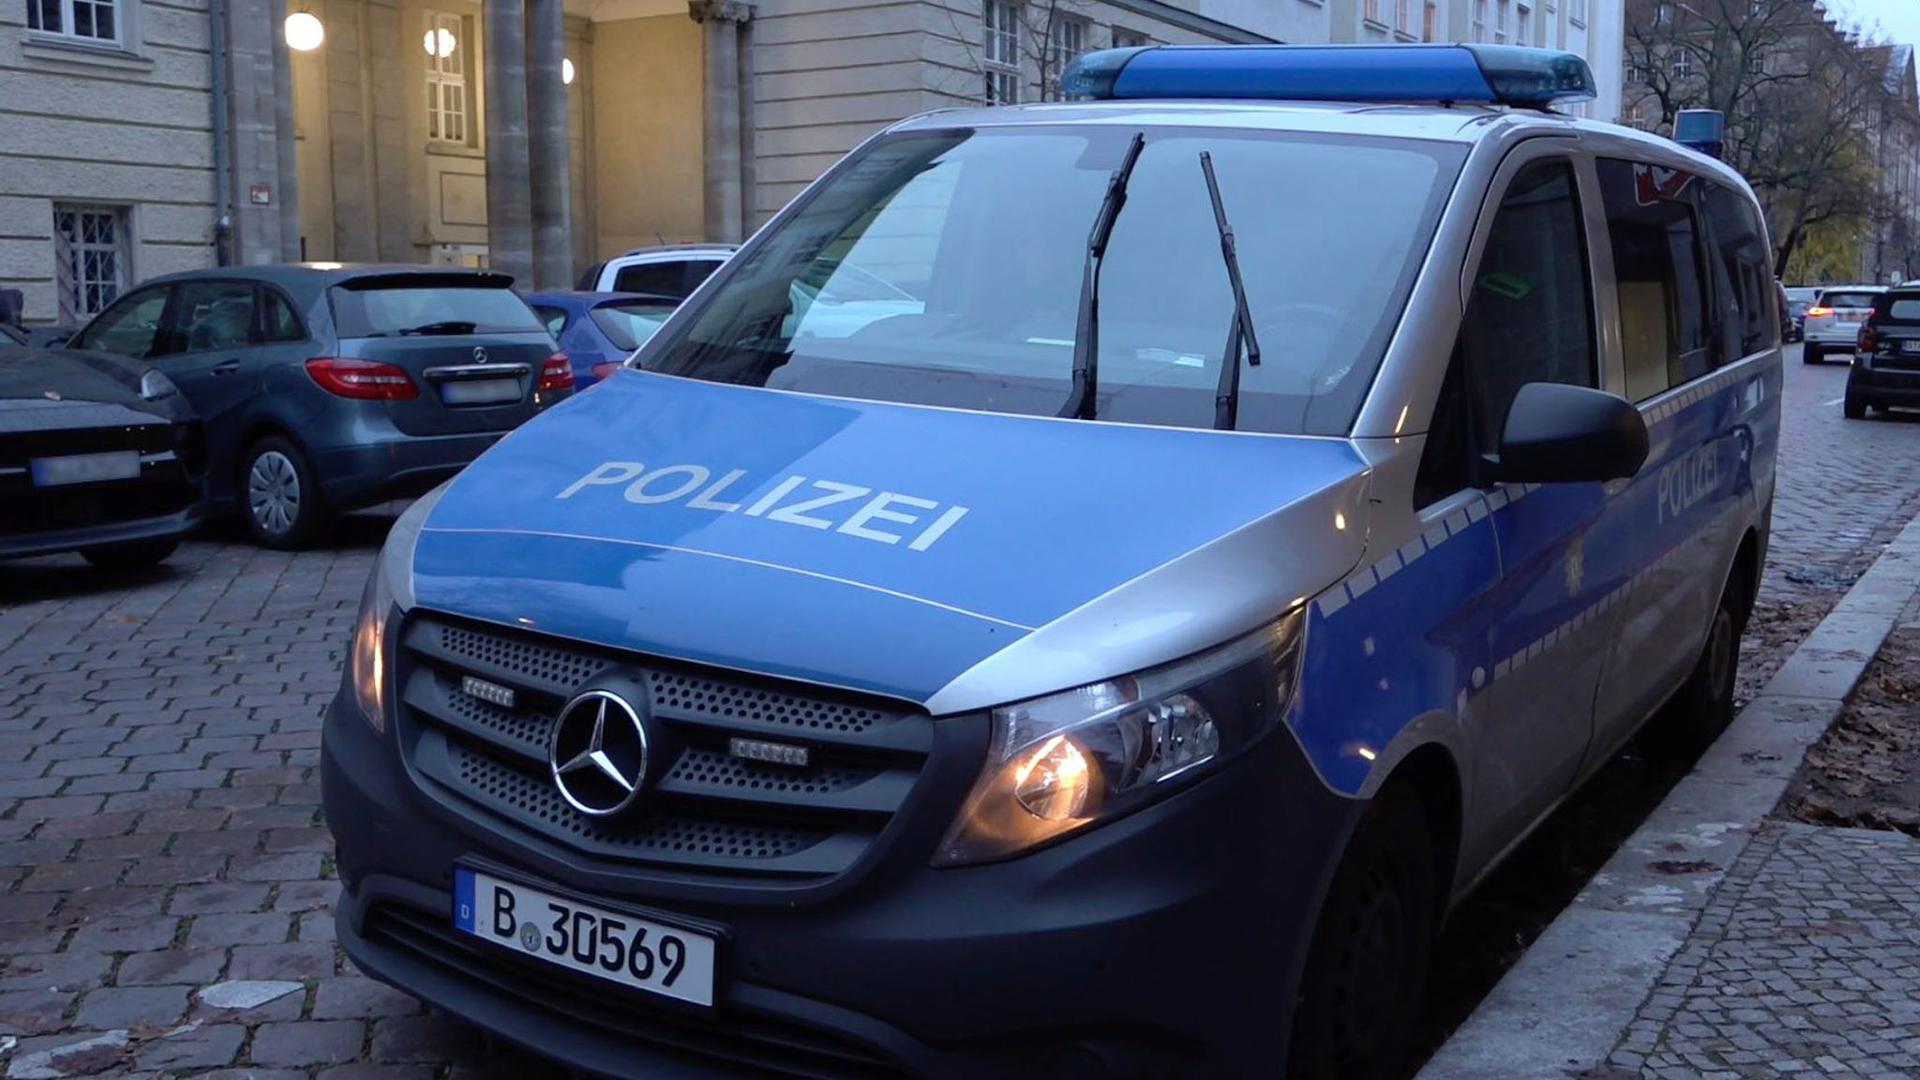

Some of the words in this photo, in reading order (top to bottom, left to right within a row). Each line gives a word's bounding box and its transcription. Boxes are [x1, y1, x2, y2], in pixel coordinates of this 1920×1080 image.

[557, 461, 969, 551] POLIZEI
[1659, 444, 1718, 524] POLIZEI
[461, 904, 470, 919] D
[495, 886, 516, 938] B
[546, 903, 686, 987] 30569
